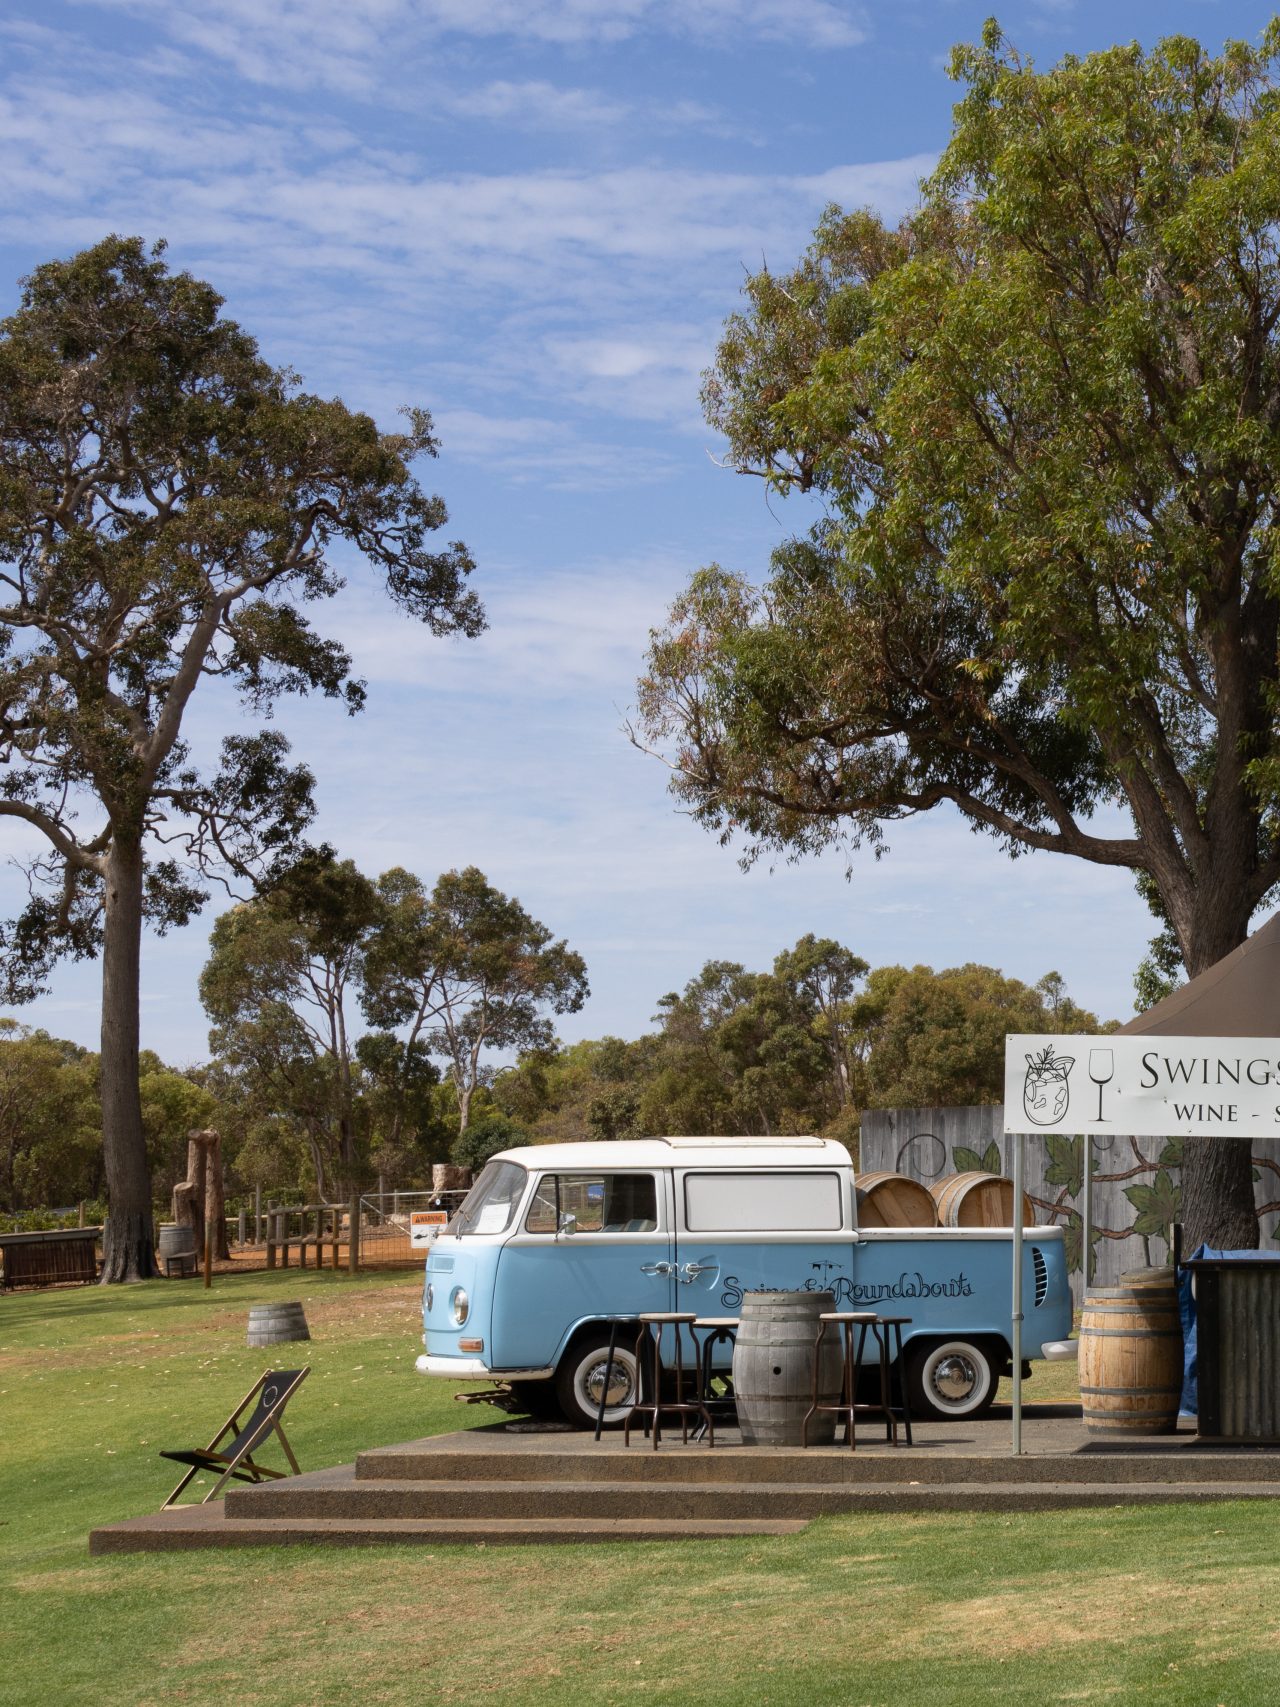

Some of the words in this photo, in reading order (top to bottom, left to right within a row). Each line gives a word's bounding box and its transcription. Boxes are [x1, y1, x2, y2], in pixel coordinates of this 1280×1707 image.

[1173, 1103, 1238, 1122] WINE
[420, 1215, 443, 1223] WARNING
[829, 1272, 976, 1306] Roundabouts
